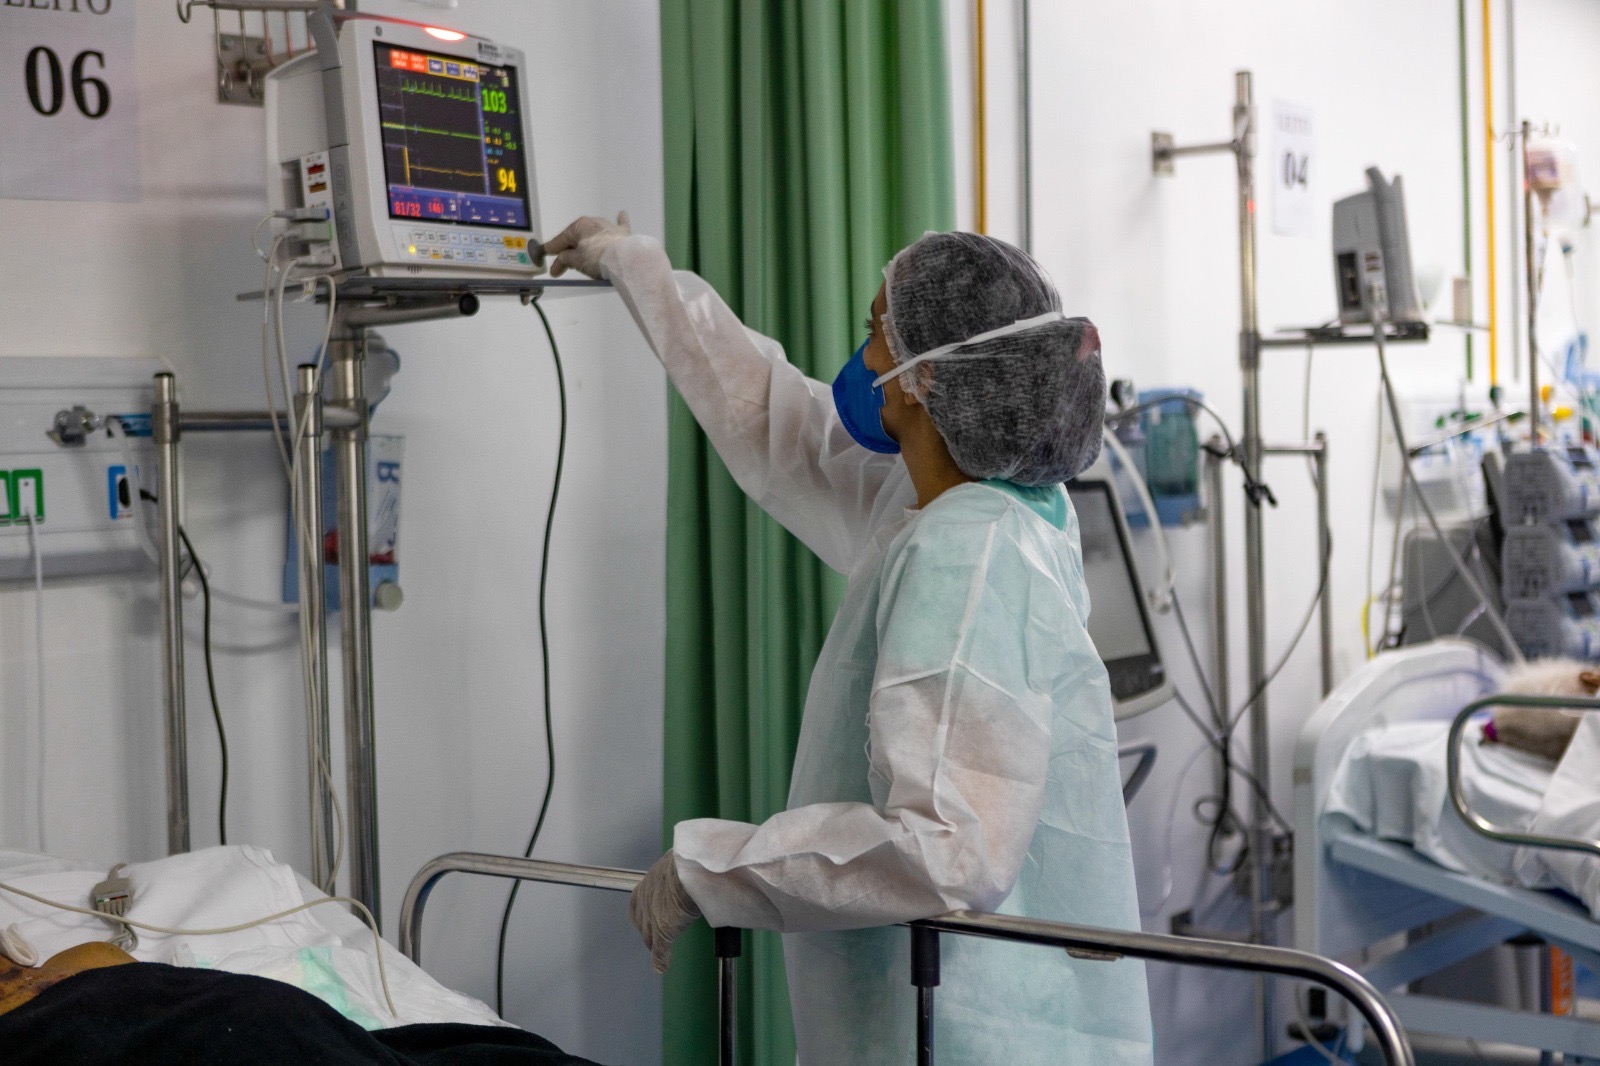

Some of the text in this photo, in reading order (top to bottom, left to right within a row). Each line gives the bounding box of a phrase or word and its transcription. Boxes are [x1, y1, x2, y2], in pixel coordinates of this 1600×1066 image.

[25, 45, 112, 119] 06
[482, 89, 507, 114] 103
[497, 168, 516, 192] 94
[1284, 151, 1309, 191] 04
[394, 201, 421, 217] 81/32
